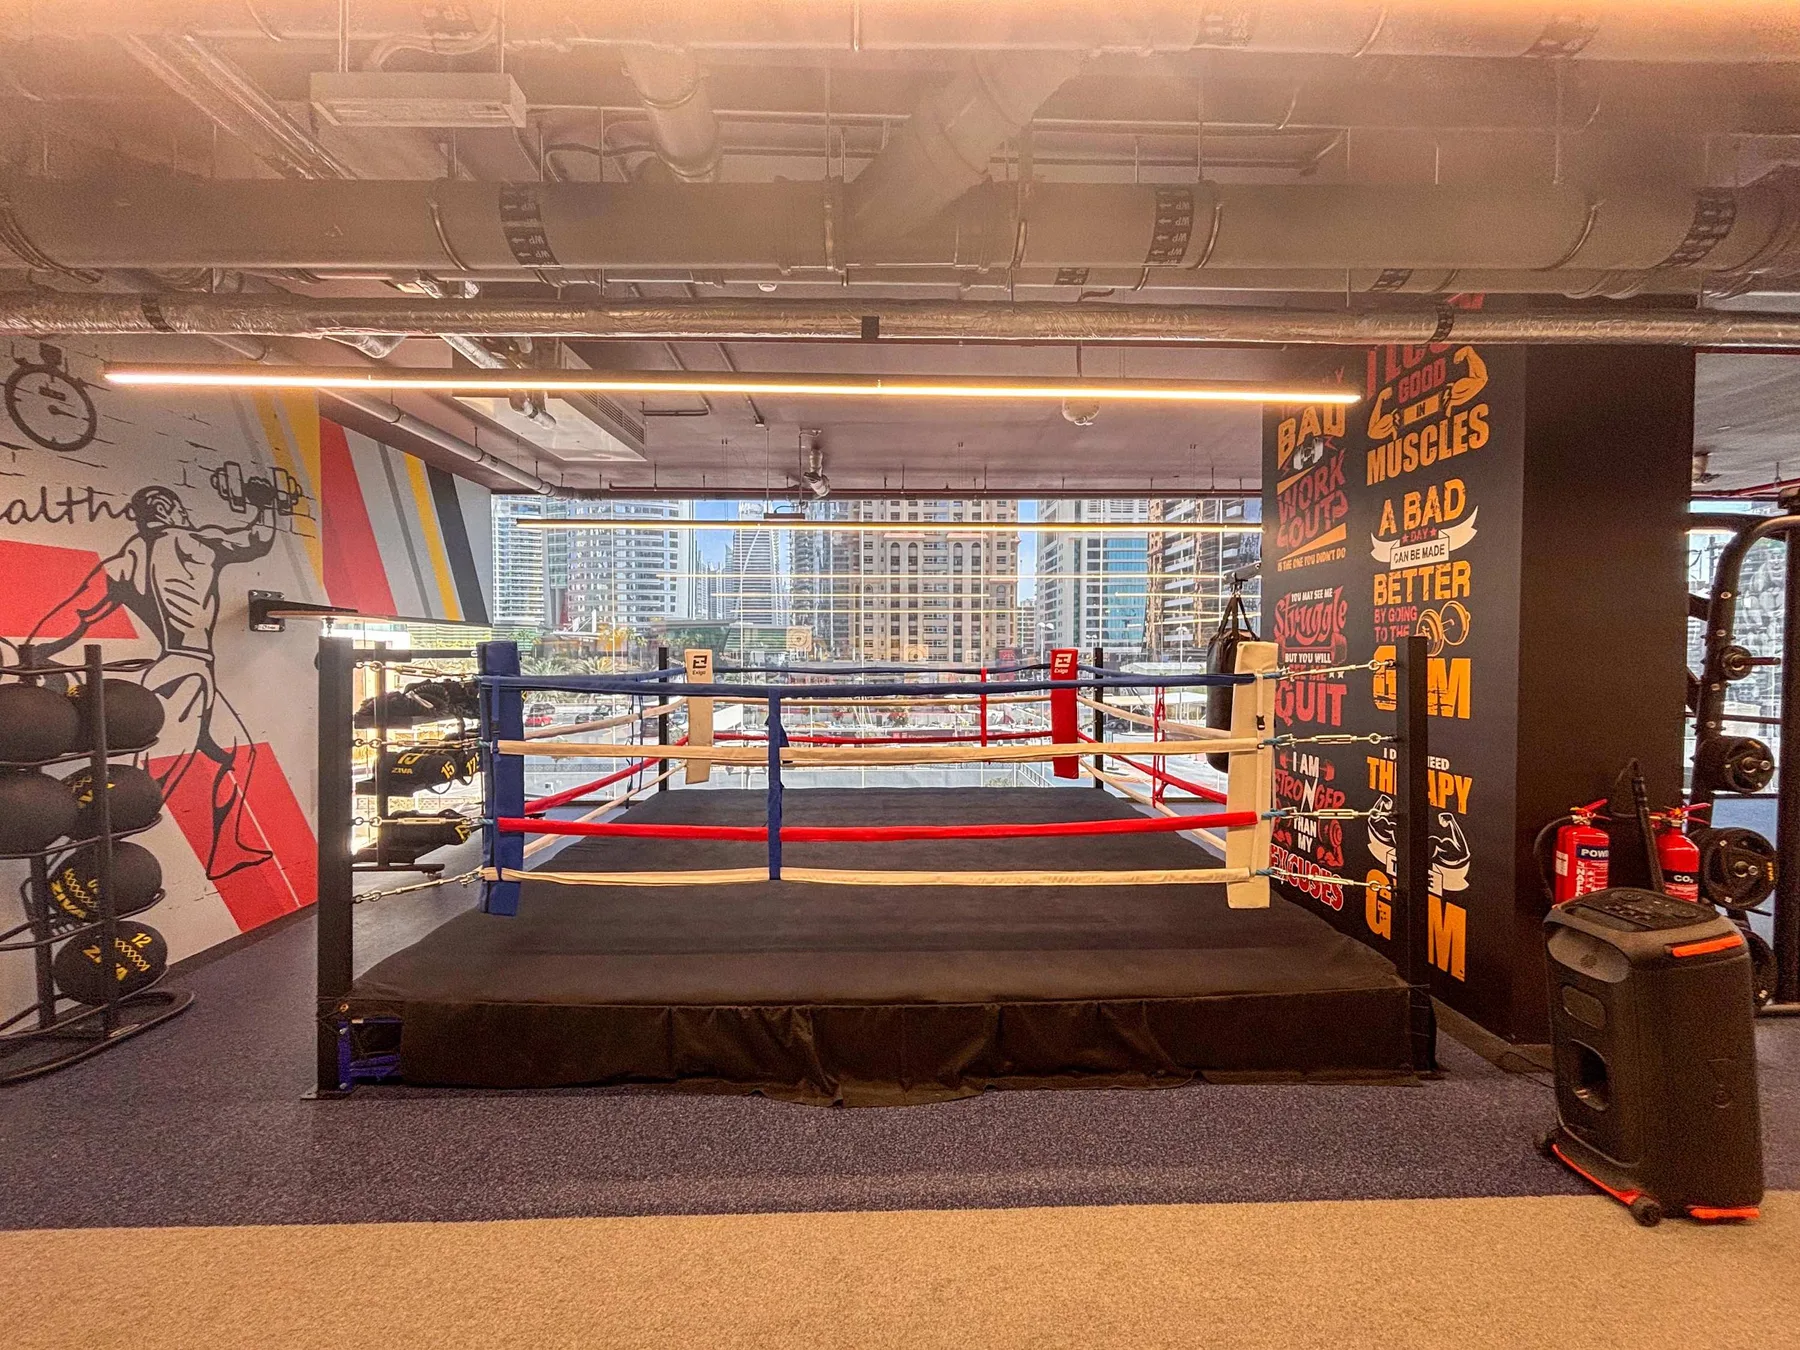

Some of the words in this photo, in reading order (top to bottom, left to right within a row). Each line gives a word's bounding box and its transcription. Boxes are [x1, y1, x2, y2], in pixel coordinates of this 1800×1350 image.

[1398, 358, 1446, 403] GOOD
[1366, 404, 1490, 487] MUSCLES
[1277, 449, 1347, 525] WORK
[1378, 499, 1397, 537] A
[1403, 478, 1466, 531] BAD
[1410, 530, 1429, 542] DAY
[1336, 547, 1347, 559] DO
[1393, 551, 1409, 564] CAN
[1410, 548, 1421, 561] BE
[1422, 543, 1446, 559] MADE
[1291, 592, 1302, 603] YOU
[1302, 590, 1313, 601] MAY
[1314, 589, 1324, 600] SEE
[1324, 587, 1333, 598] ME
[1373, 560, 1472, 606] BETTER
[1273, 585, 1348, 646] Struggle
[1374, 608, 1387, 624] BY
[1388, 606, 1418, 623] GOING
[1374, 626, 1388, 643] TO
[1284, 653, 1298, 663] BUT
[1298, 653, 1313, 664] YOU
[1314, 652, 1332, 664] WILL
[1373, 645, 1471, 720] GM
[1275, 679, 1348, 727] QUIT
[391, 766, 413, 775] ZIVA
[440, 760, 455, 779] 15
[1292, 751, 1297, 772] I
[1300, 753, 1320, 778] AM
[1366, 756, 1473, 815] THAPY
[1294, 816, 1317, 838] THAN
[1297, 832, 1313, 853] MY
[1270, 843, 1344, 912] EXCUSES
[1366, 868, 1467, 983] GM
[131, 932, 153, 948] 12
